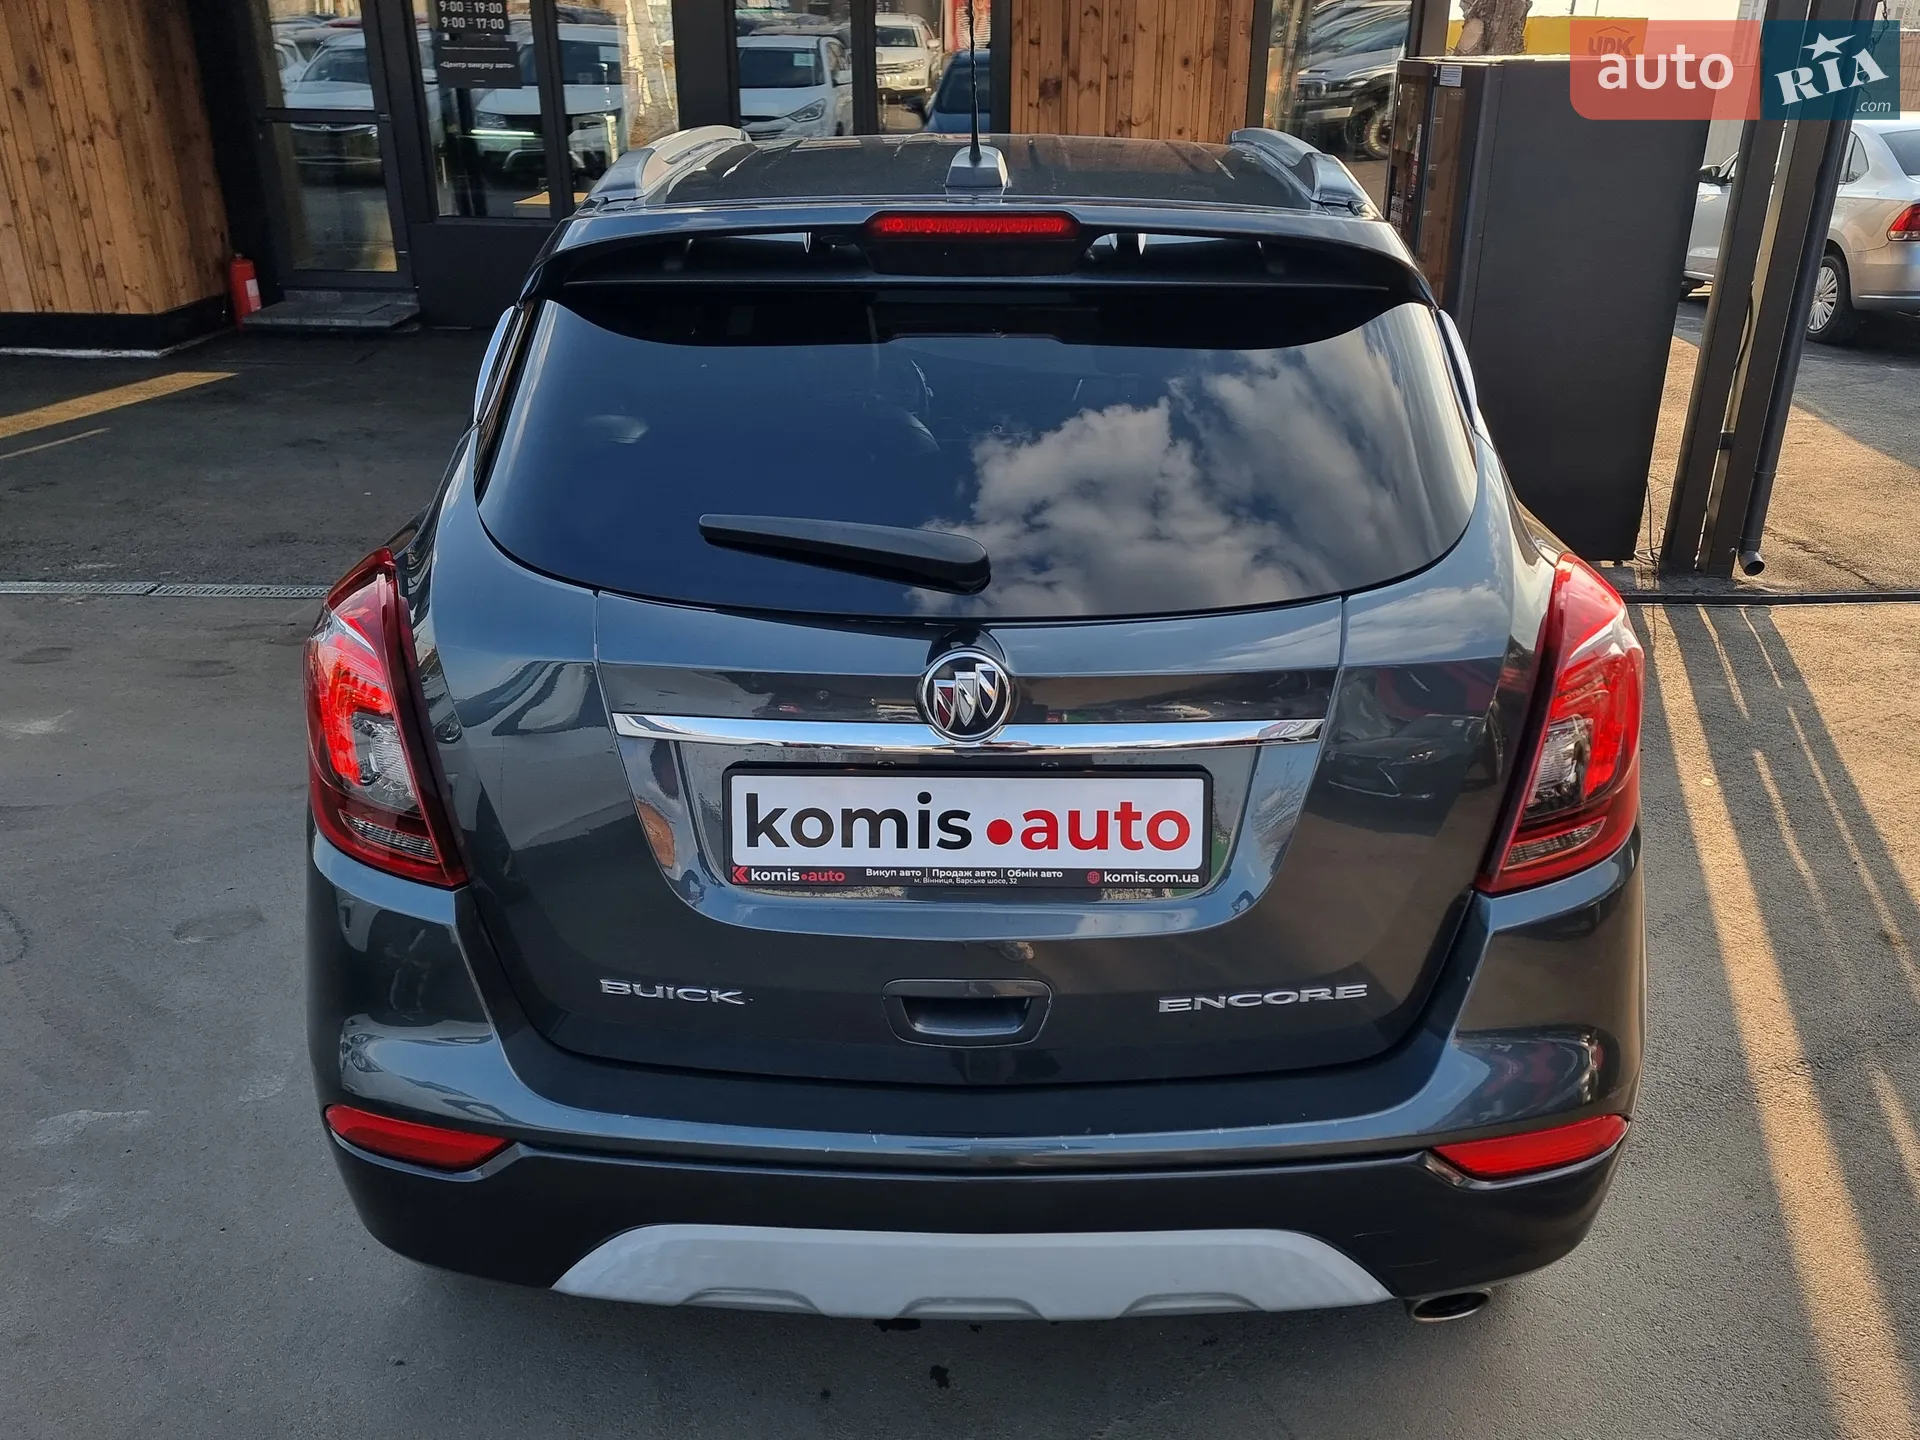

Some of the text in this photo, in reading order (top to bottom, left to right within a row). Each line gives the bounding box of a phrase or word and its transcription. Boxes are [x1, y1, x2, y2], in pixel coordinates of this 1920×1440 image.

[440, 1, 503, 13] 9:00 19:00
[441, 17, 504, 29] 9:00 17:00
[745, 792, 972, 850] komis
[866, 868, 1063, 879] Викуп авто Продаж авто Обмін авто
[1104, 871, 1200, 884] komis.com.ua
[923, 877, 955, 885] Вінниця,
[599, 979, 745, 1005] BUICK
[1158, 983, 1368, 1013] ENCORE
